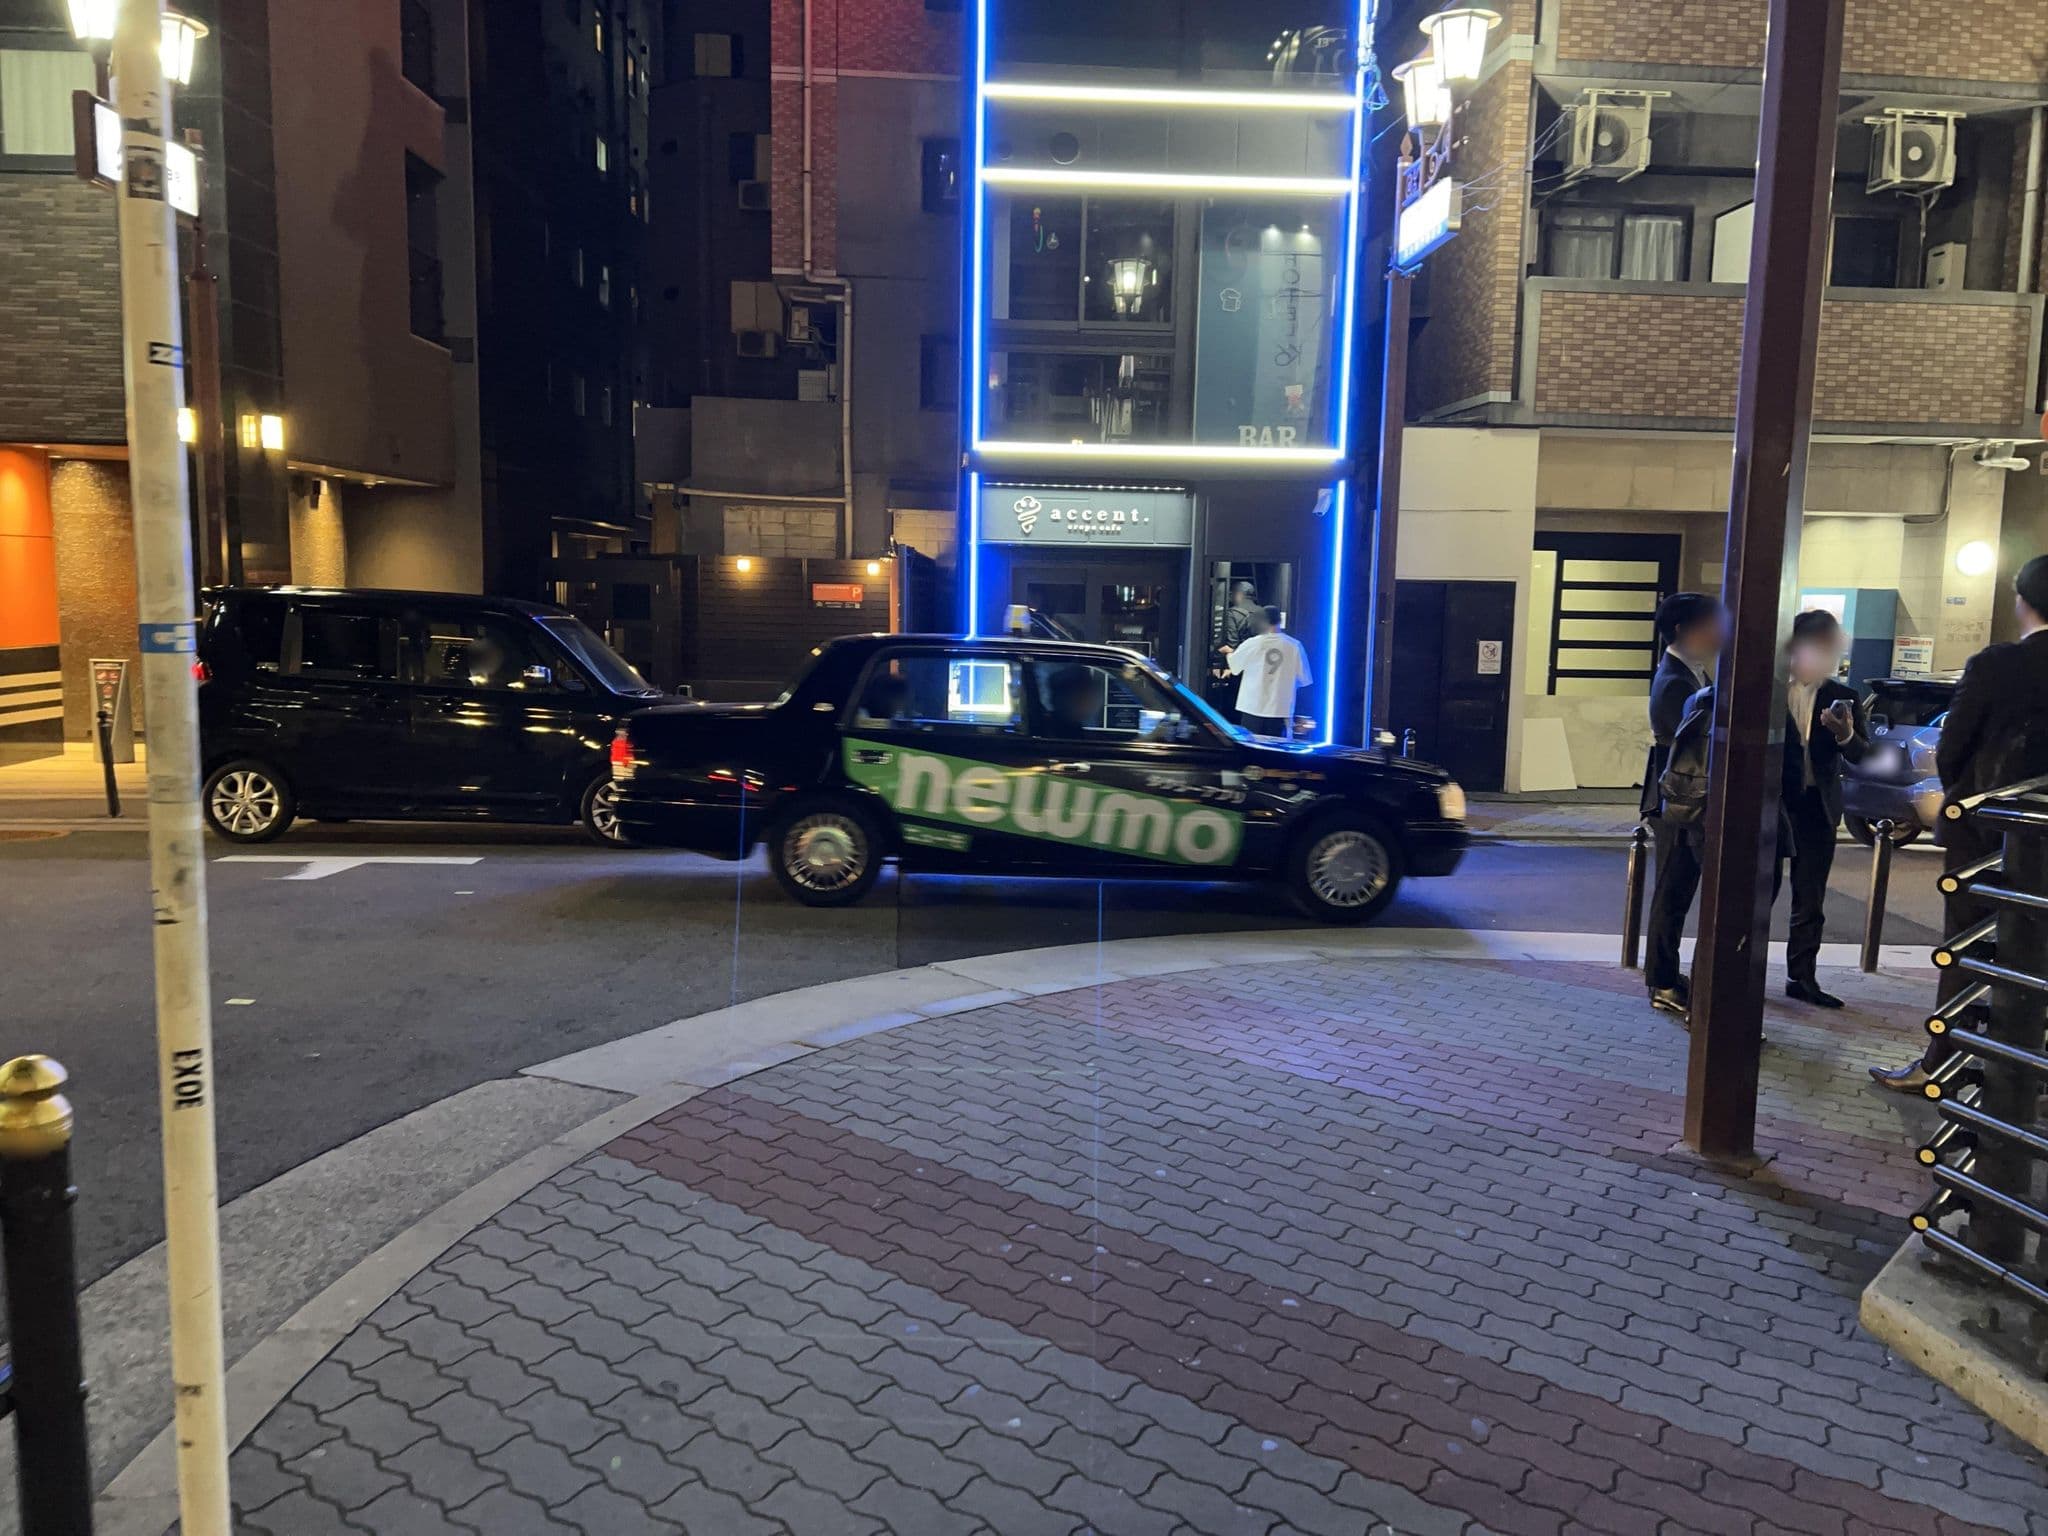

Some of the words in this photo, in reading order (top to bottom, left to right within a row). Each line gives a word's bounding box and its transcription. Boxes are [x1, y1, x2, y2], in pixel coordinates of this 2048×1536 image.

[1238, 425, 1297, 448] BAR
[1050, 508, 1150, 523] accent.
[852, 587, 862, 599] P
[1265, 648, 1284, 675] 9
[898, 752, 1235, 864] newmo
